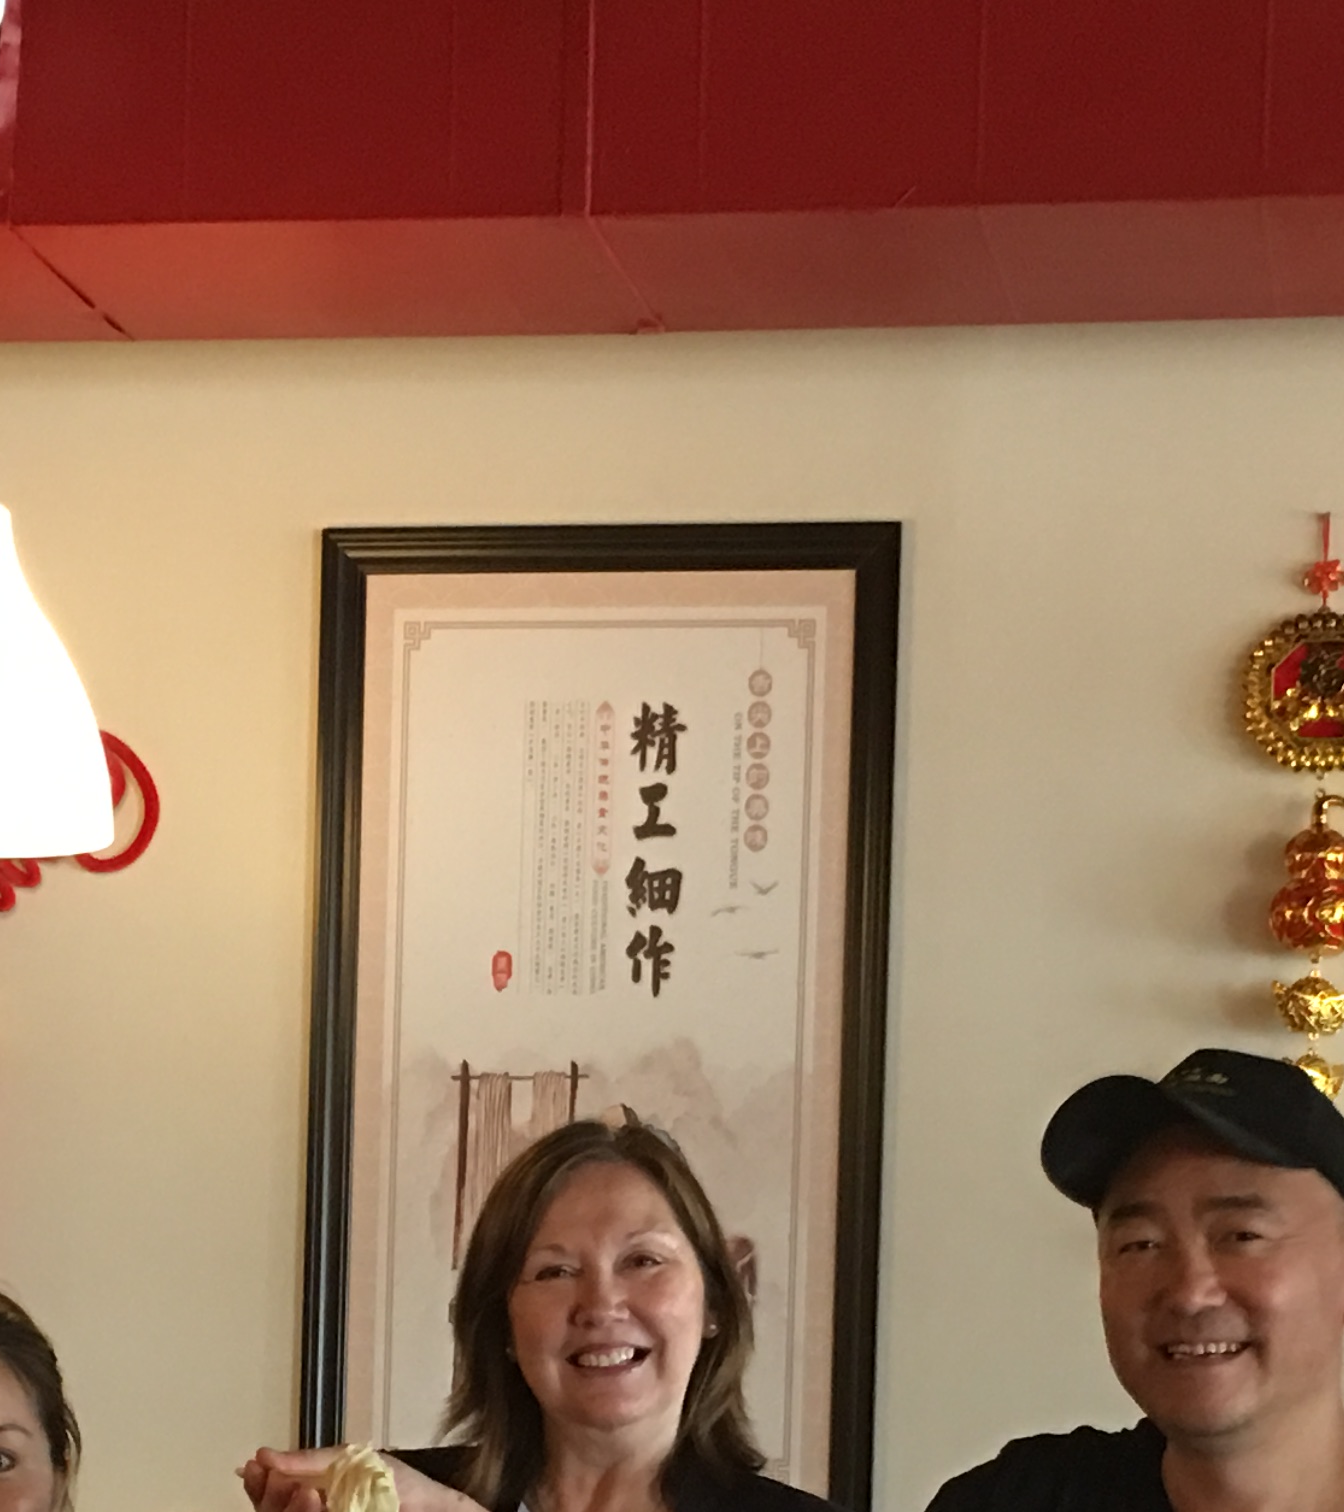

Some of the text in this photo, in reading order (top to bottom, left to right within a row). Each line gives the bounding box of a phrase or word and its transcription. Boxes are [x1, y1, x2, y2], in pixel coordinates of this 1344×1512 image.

[733, 735, 742, 759] THE
[732, 765, 741, 783] TIP
[731, 786, 741, 803] OF
[731, 809, 740, 833] THE
[625, 700, 688, 998] 精工細作
[729, 838, 739, 889] TONGUE
